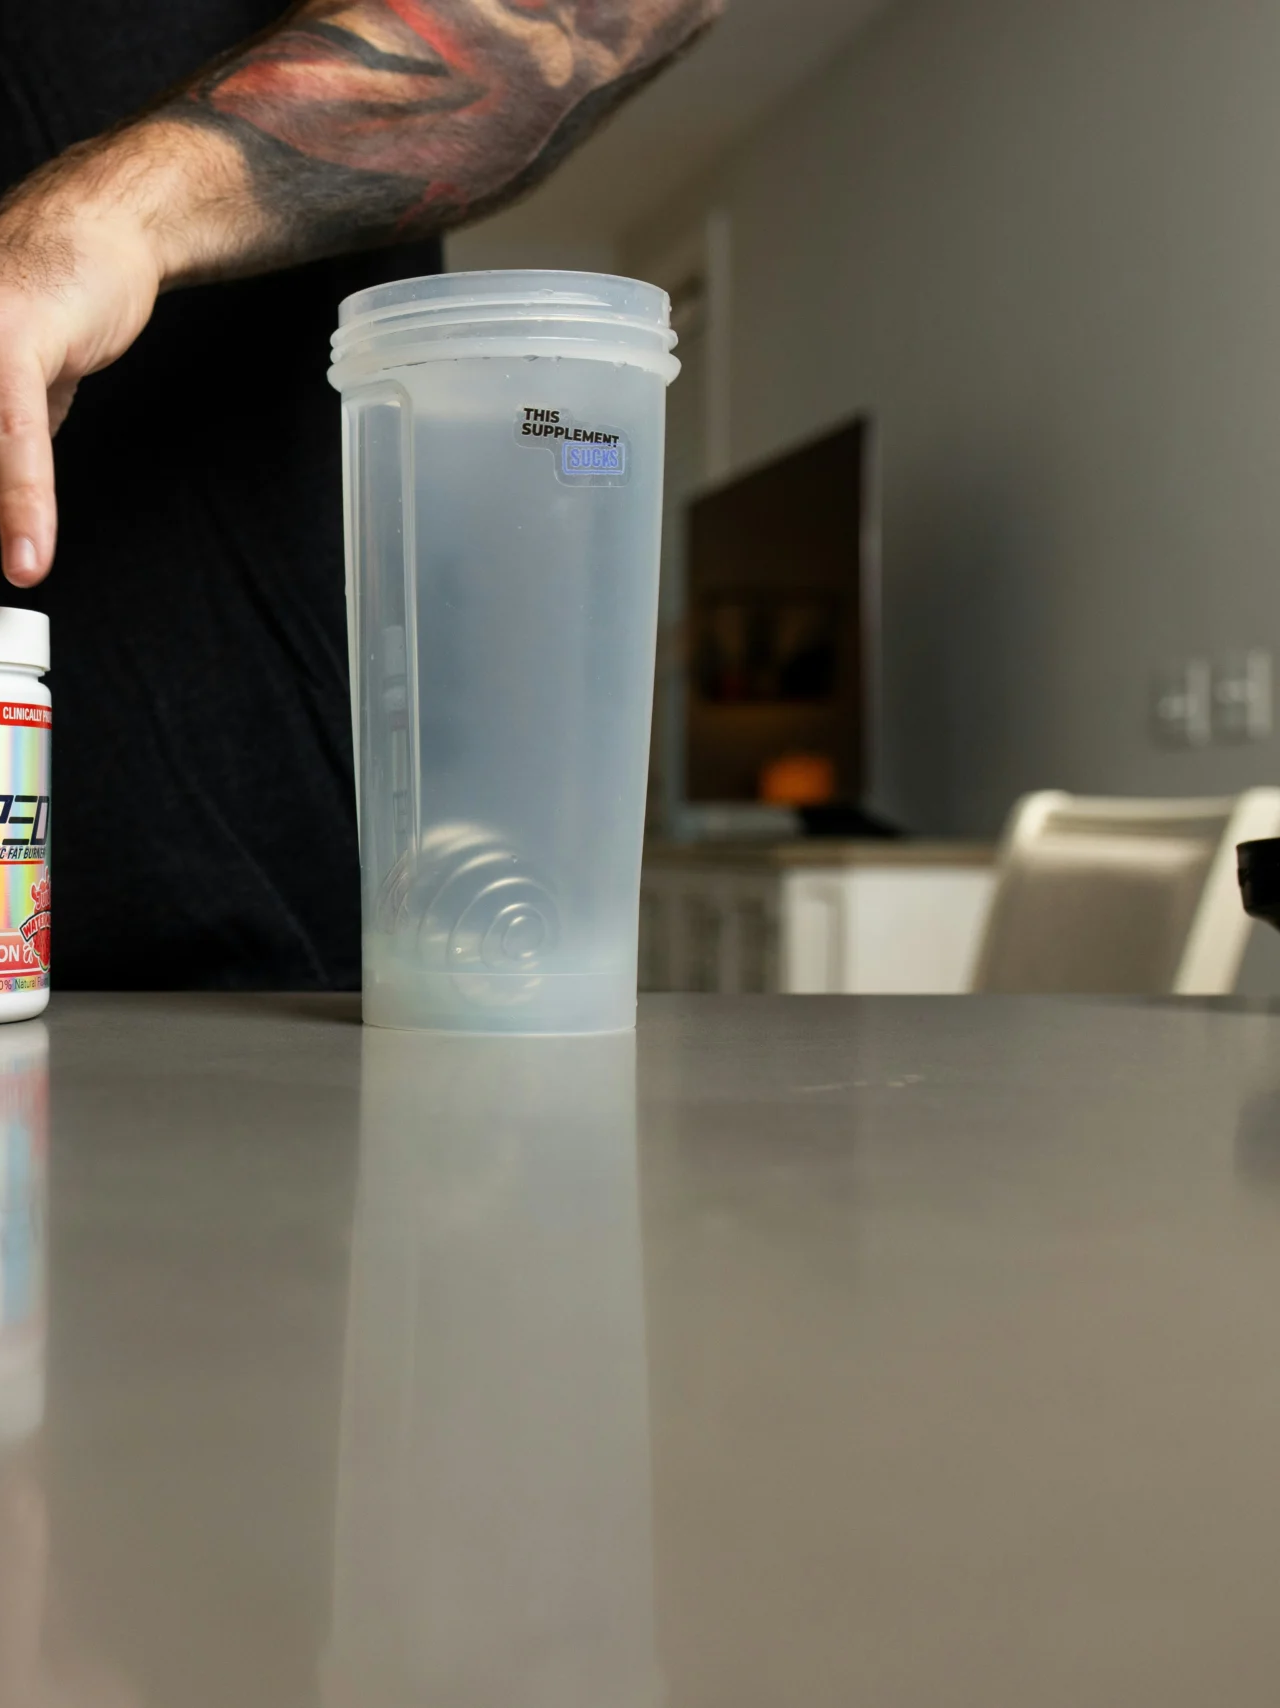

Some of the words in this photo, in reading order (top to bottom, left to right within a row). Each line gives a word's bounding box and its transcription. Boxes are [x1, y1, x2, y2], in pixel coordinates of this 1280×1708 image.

[523, 408, 560, 424] THIS
[521, 423, 620, 447] SUPPLEMENT
[570, 448, 618, 468] SUCKS
[2, 706, 42, 722] CLINICALLY
[7, 847, 23, 859] FAT
